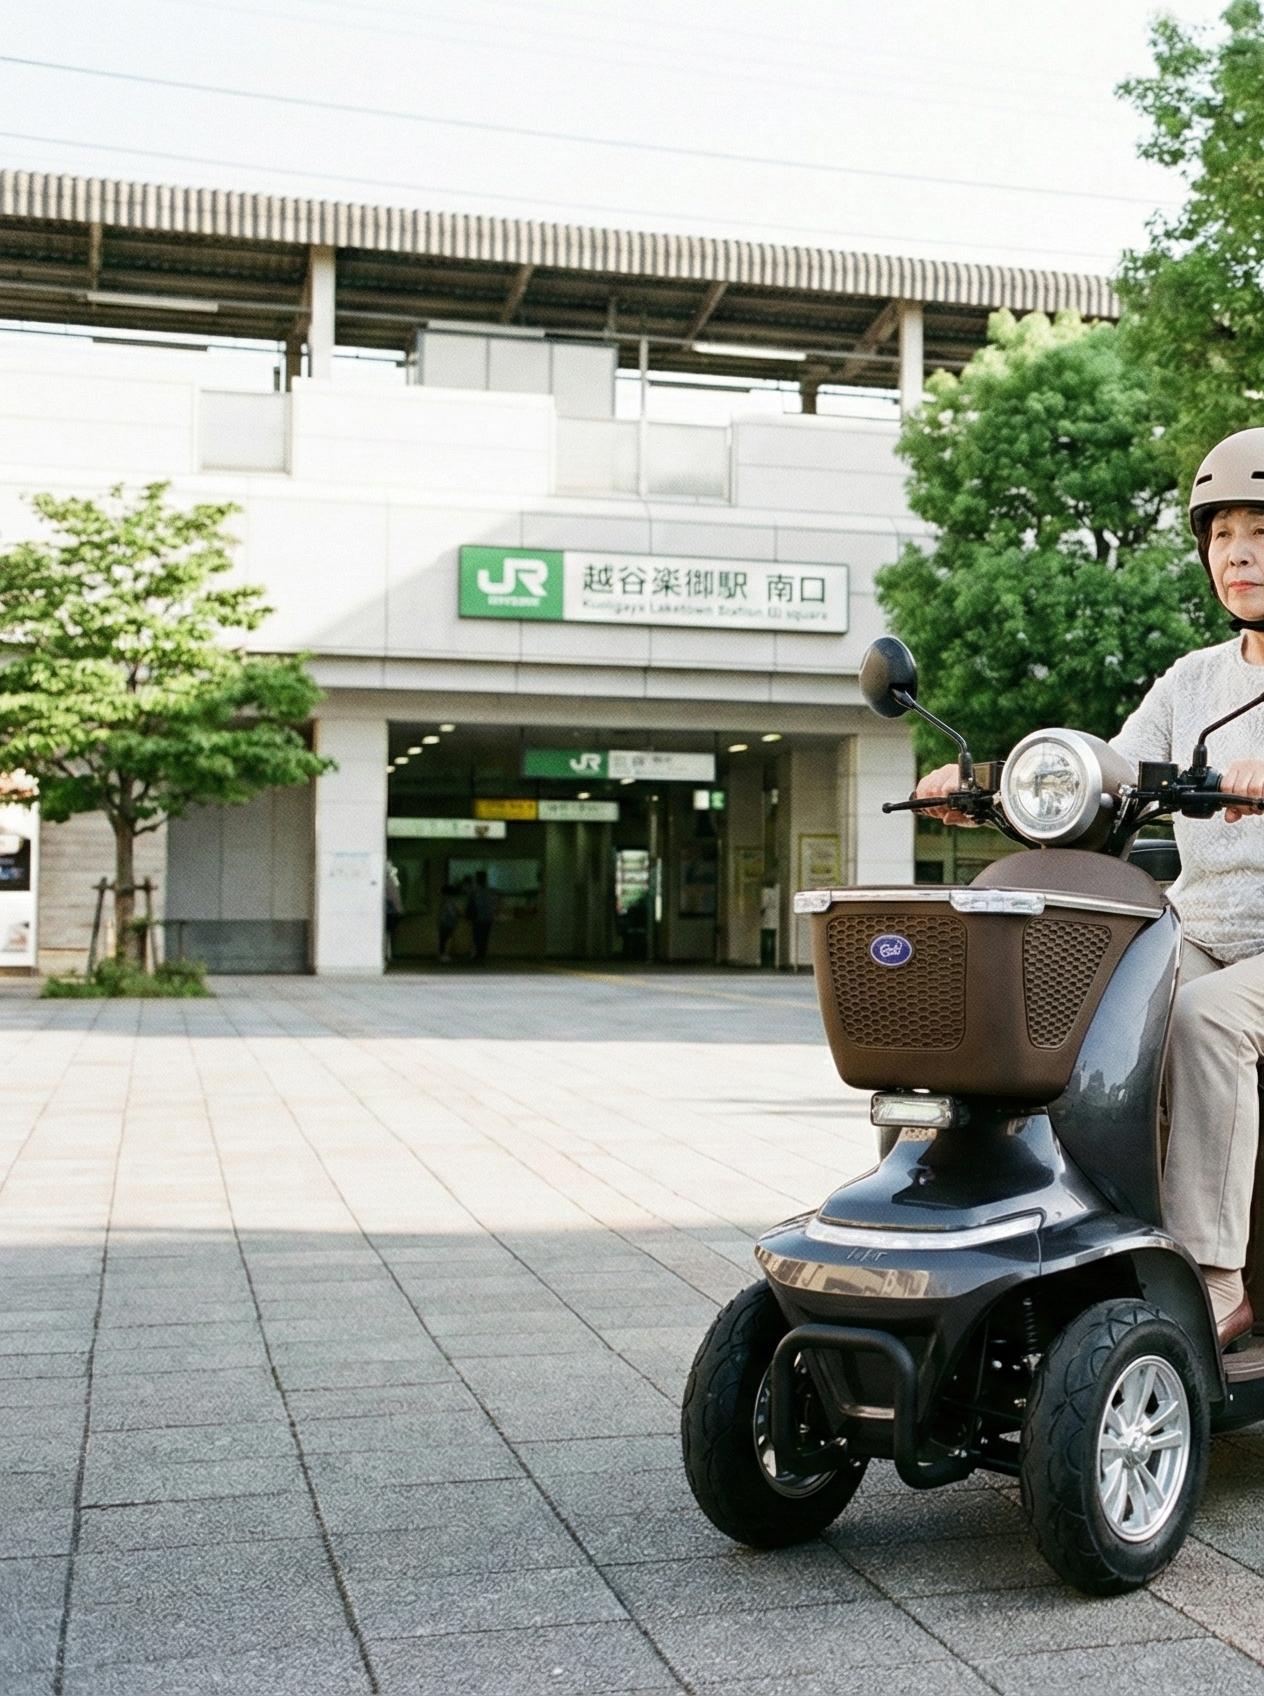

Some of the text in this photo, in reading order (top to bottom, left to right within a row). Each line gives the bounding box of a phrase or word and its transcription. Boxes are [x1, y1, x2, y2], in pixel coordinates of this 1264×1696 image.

[477, 557, 548, 596] JR
[766, 574, 826, 602] 南口
[569, 753, 601, 771] JR
